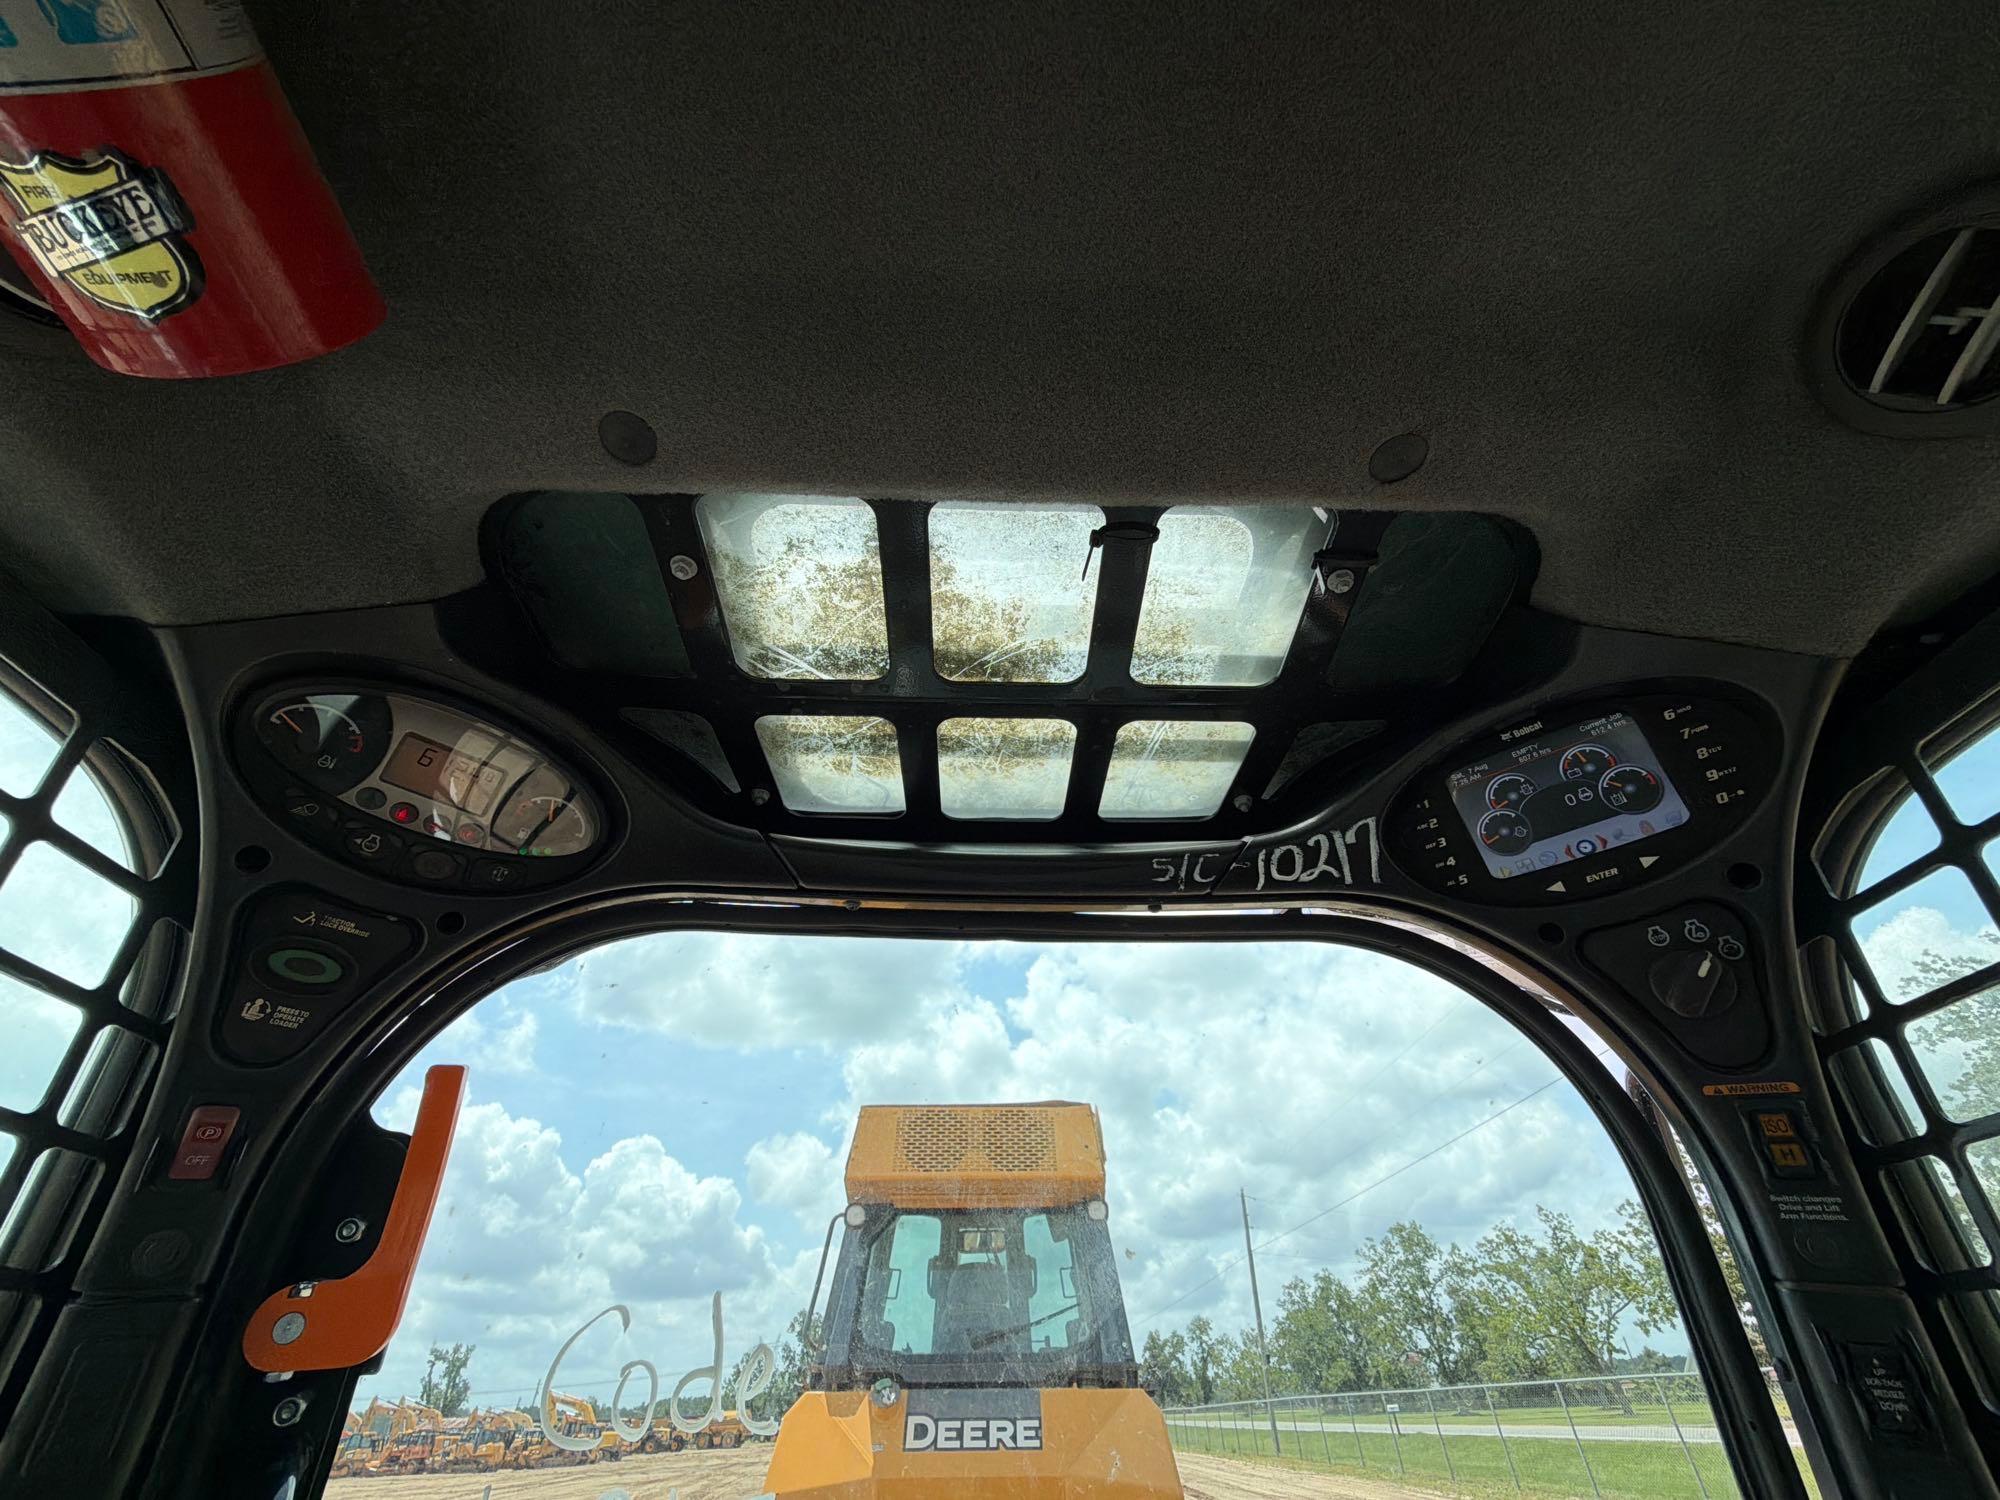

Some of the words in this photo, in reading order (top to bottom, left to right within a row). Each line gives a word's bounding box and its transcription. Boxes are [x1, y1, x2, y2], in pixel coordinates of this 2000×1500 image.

[20, 185, 56, 198] FIRE
[84, 270, 172, 286] EQUIPMENT
[1663, 708, 1675, 720] 6
[1513, 721, 1544, 738] Bobcat
[1680, 727, 1690, 739] 7
[1511, 744, 1538, 758] EMPTY
[1696, 747, 1709, 759] 8
[1706, 769, 1719, 781] 9
[1716, 792, 1728, 804] 0
[1428, 817, 1439, 829] 2
[1437, 837, 1447, 848] 3
[1446, 856, 1456, 867] 4
[1458, 874, 1468, 885] 5
[1586, 867, 1619, 883] ENTER
[273, 1012, 305, 1023] OPERATE
[276, 1005, 300, 1016] PRESS
[300, 1010, 310, 1018] TO
[1726, 1083, 1790, 1094] WARNING
[1762, 1118, 1790, 1134] ISO
[1781, 1148, 1797, 1162] H
[1769, 1195, 1800, 1203] Switch
[1803, 1195, 1842, 1204] changes
[1778, 1203, 1802, 1212] Drive
[1805, 1203, 1822, 1212] and
[1824, 1204, 1840, 1212] Lift
[1780, 1212, 1799, 1220] Arm
[541, 1290, 778, 1451] Code
[906, 1416, 1042, 1449] DEERE
